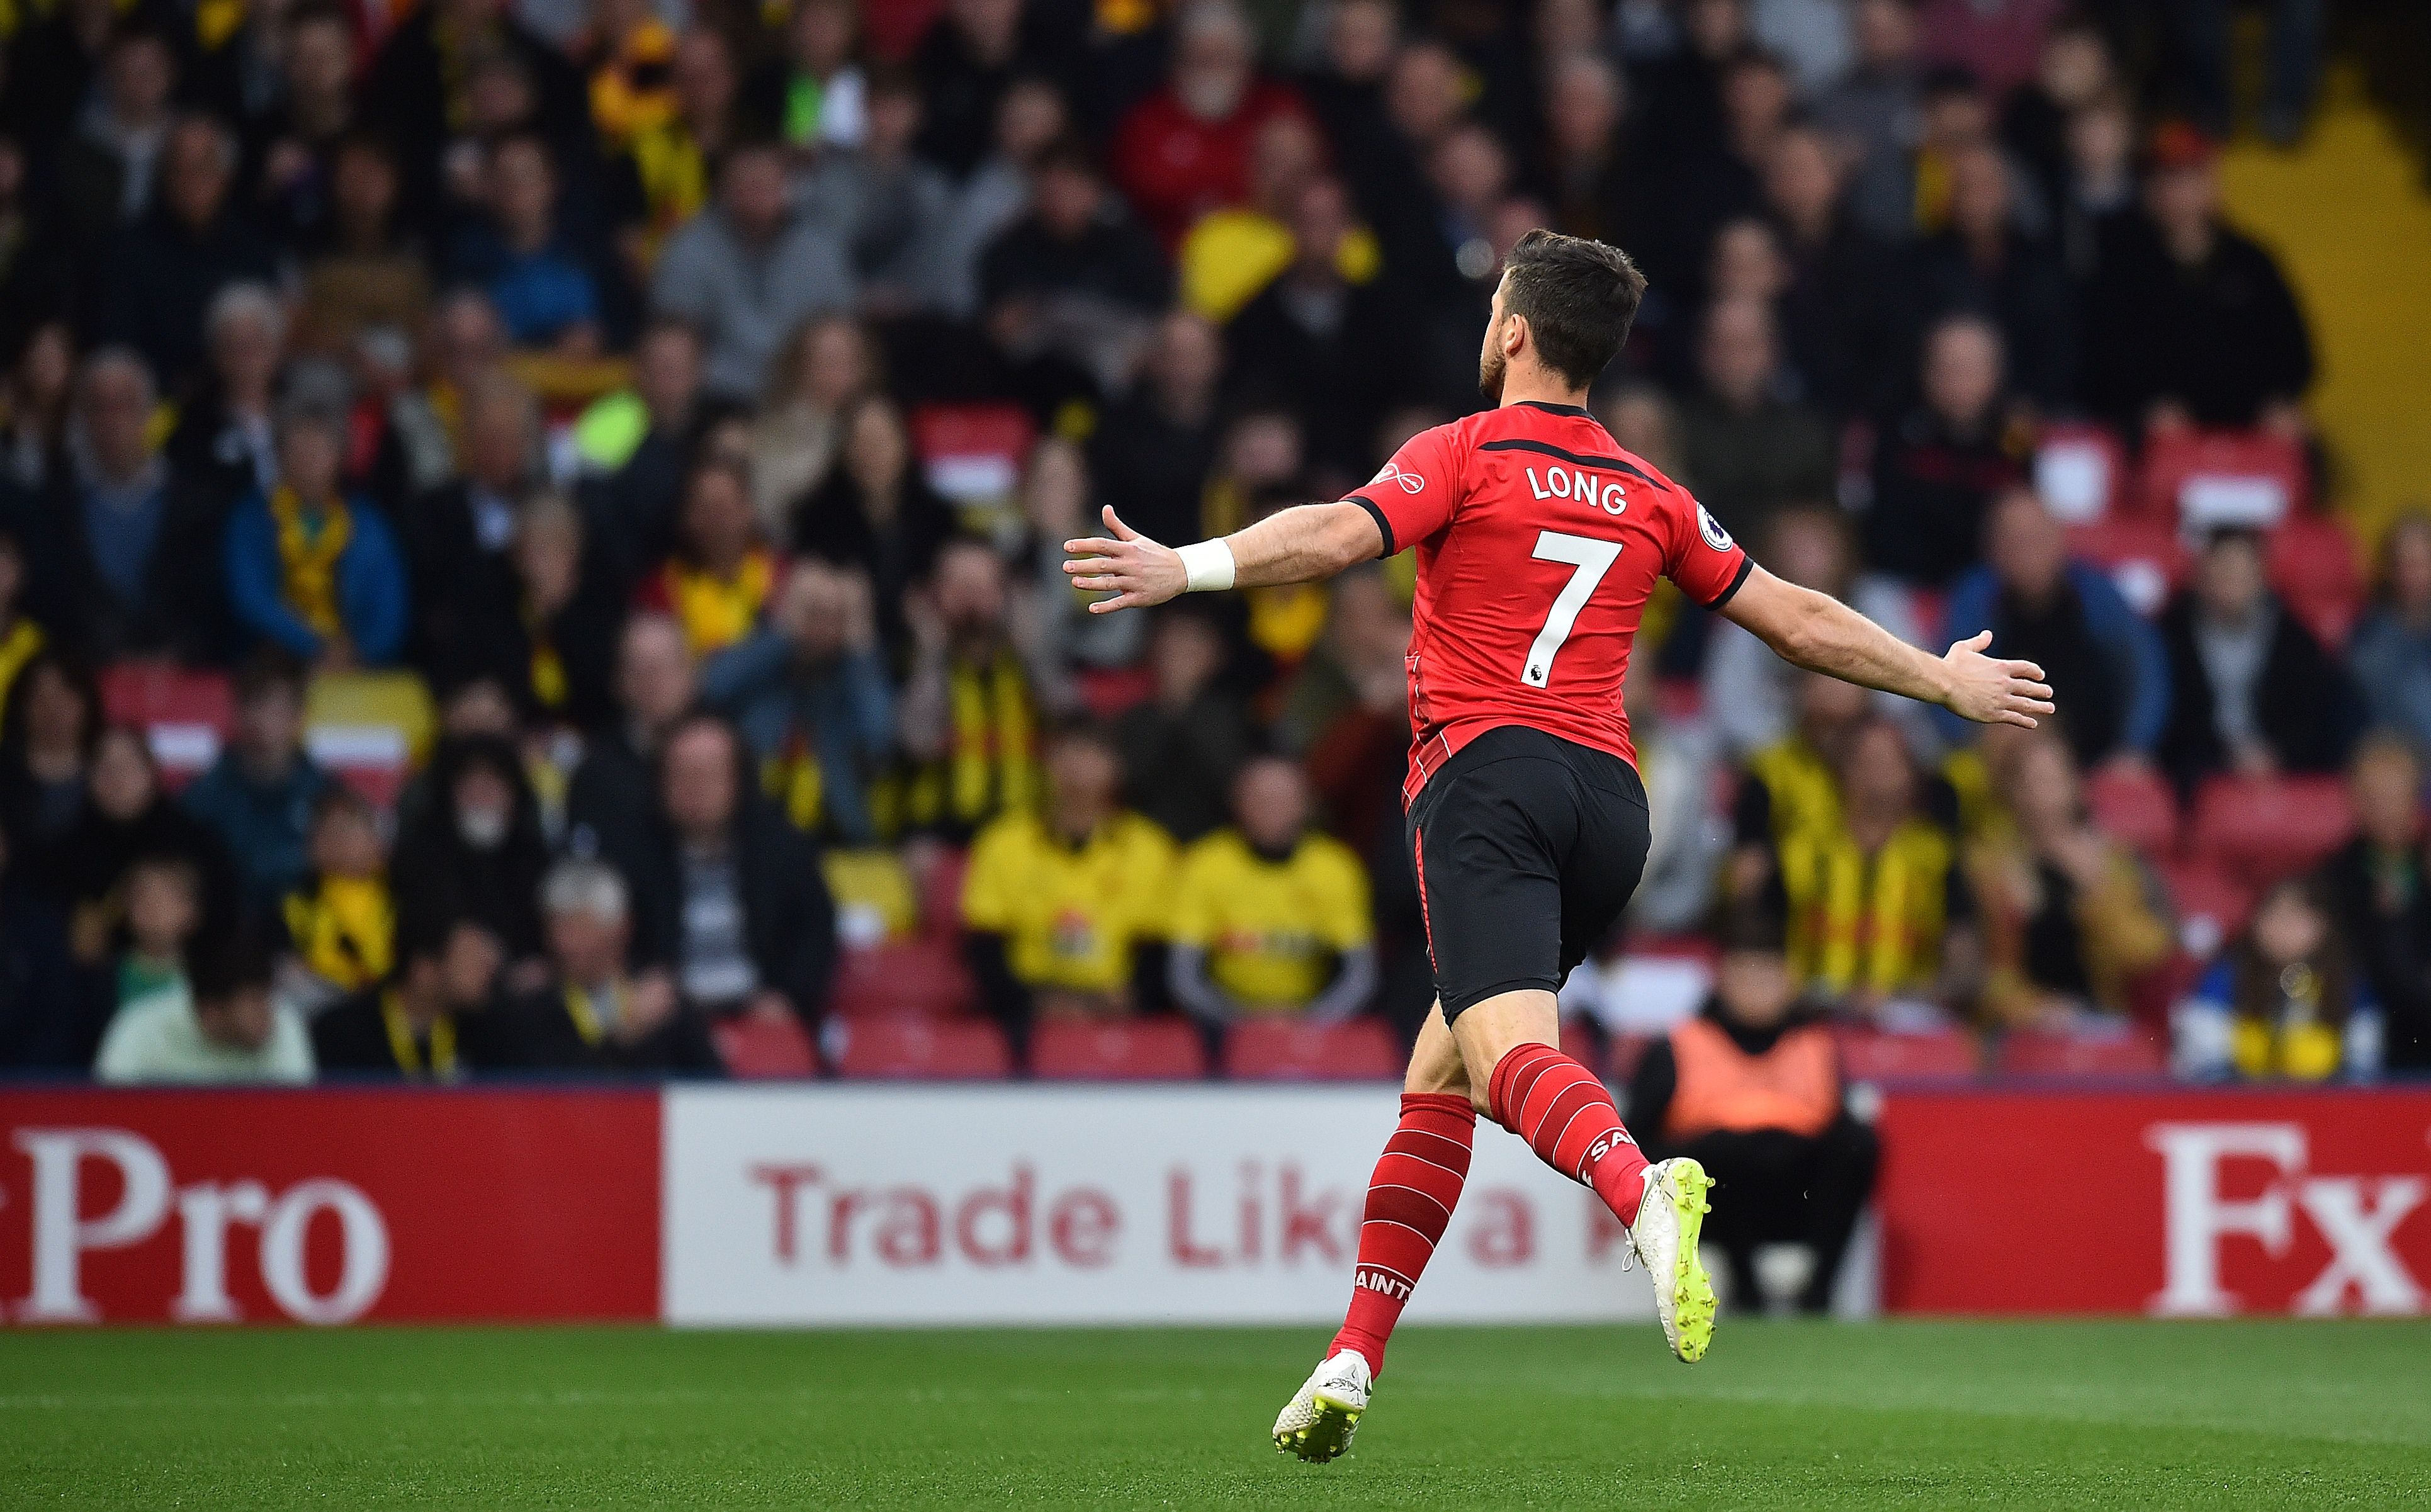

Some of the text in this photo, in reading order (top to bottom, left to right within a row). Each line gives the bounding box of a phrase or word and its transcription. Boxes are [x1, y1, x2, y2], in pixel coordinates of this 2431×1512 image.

[1525, 466, 1628, 516] LONG
[1521, 530, 1623, 689] 7
[1, 1127, 392, 1327] Pro
[748, 1159, 1122, 1270] Trade
[1165, 1159, 1366, 1270] Lik
[1464, 1183, 1541, 1271] a
[2145, 1122, 2431, 1317] Fx
